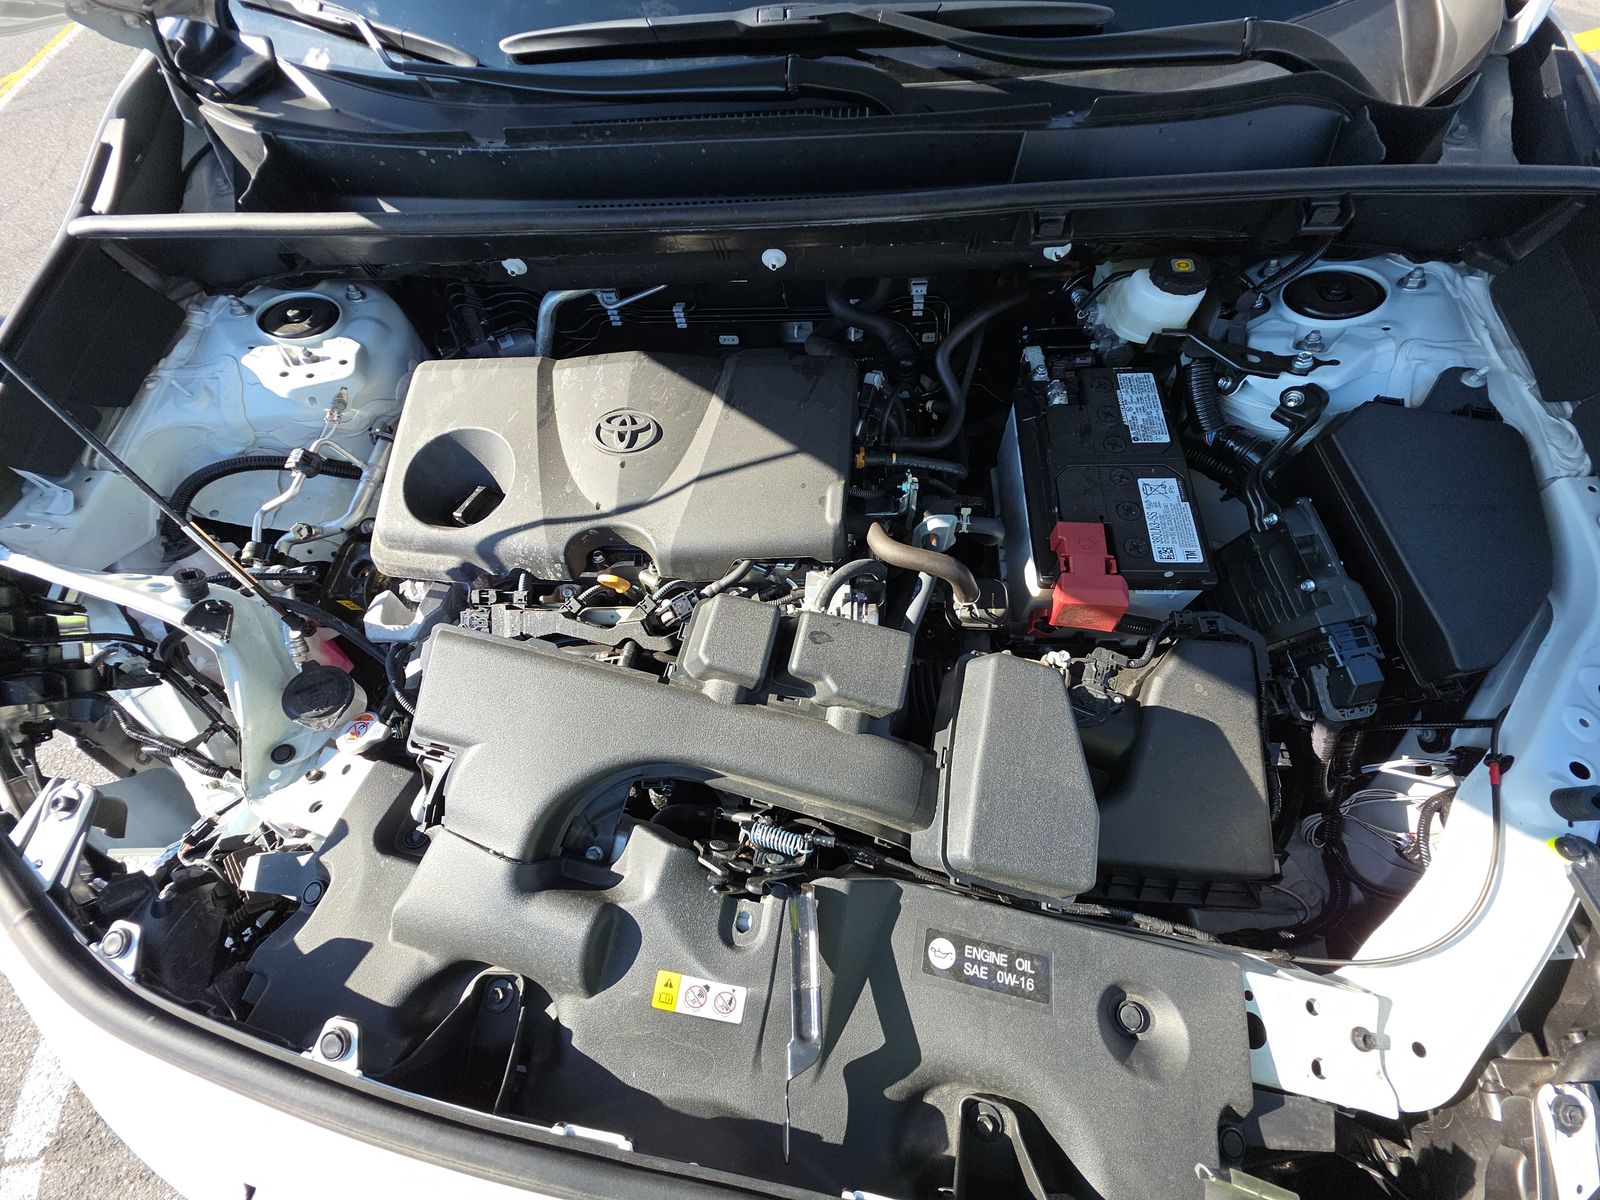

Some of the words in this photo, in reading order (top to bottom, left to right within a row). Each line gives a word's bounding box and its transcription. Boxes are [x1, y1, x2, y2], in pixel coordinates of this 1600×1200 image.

[964, 945, 1008, 967] ENGINE
[1015, 958, 1035, 974] OIL
[963, 962, 988, 980] SAE
[996, 970, 1035, 991] 0W-16
